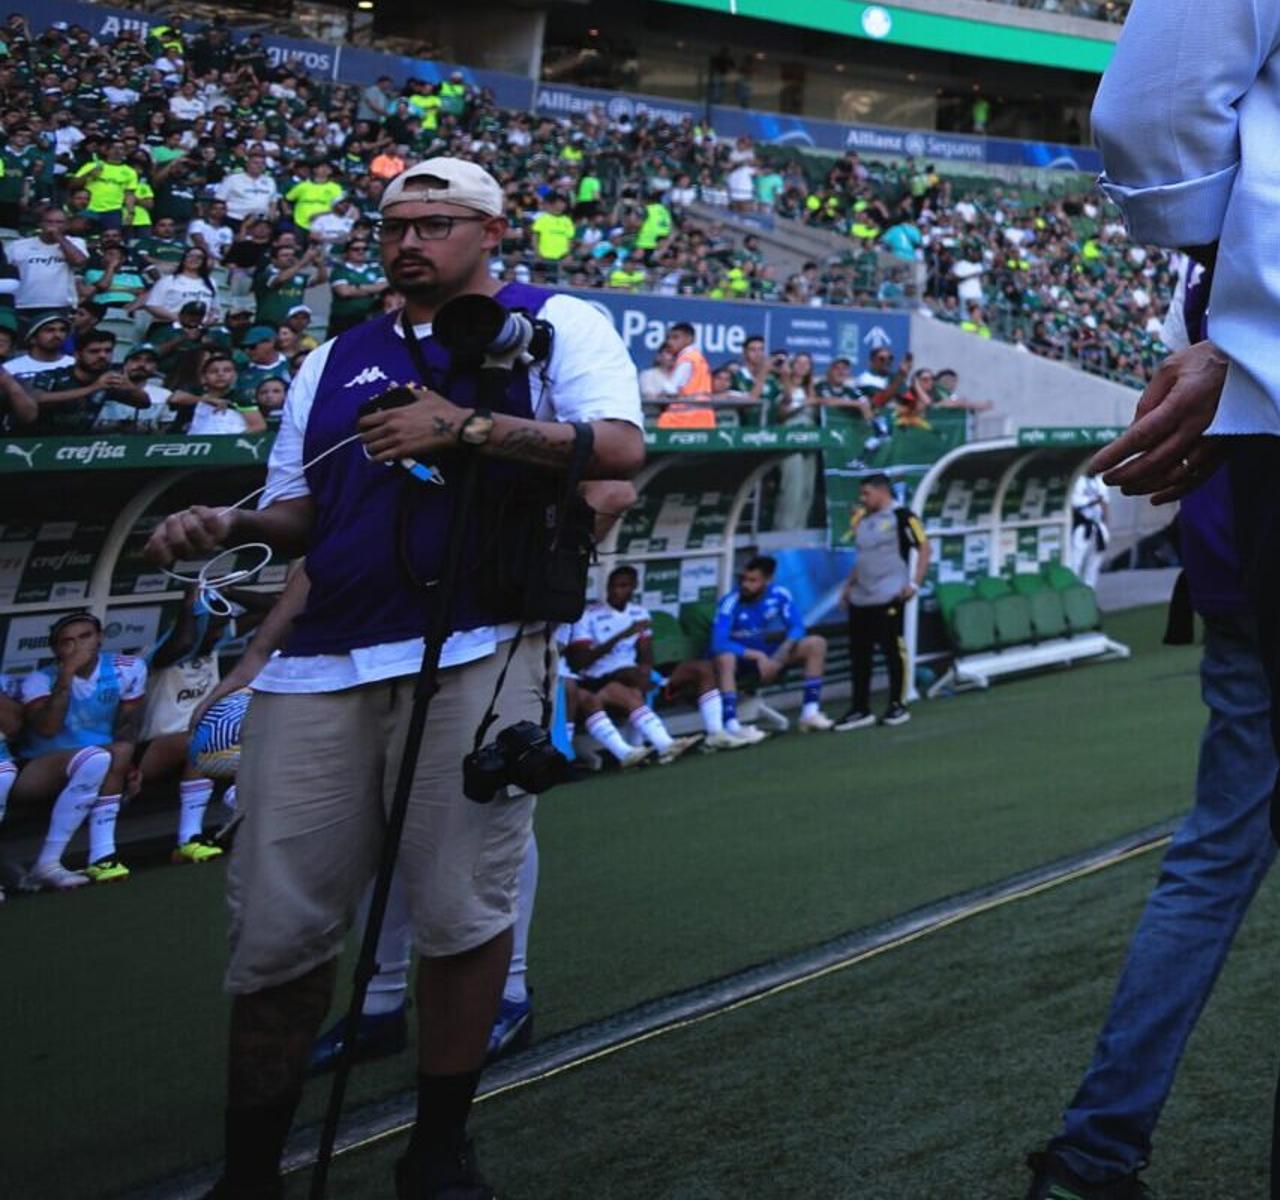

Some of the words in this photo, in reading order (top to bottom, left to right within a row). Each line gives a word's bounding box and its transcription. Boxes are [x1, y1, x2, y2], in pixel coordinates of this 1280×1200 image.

[846, 129, 902, 151] Allianz
[55, 440, 127, 465] crefisa
[31, 550, 92, 571] crefisa
[18, 635, 51, 651] PUM
